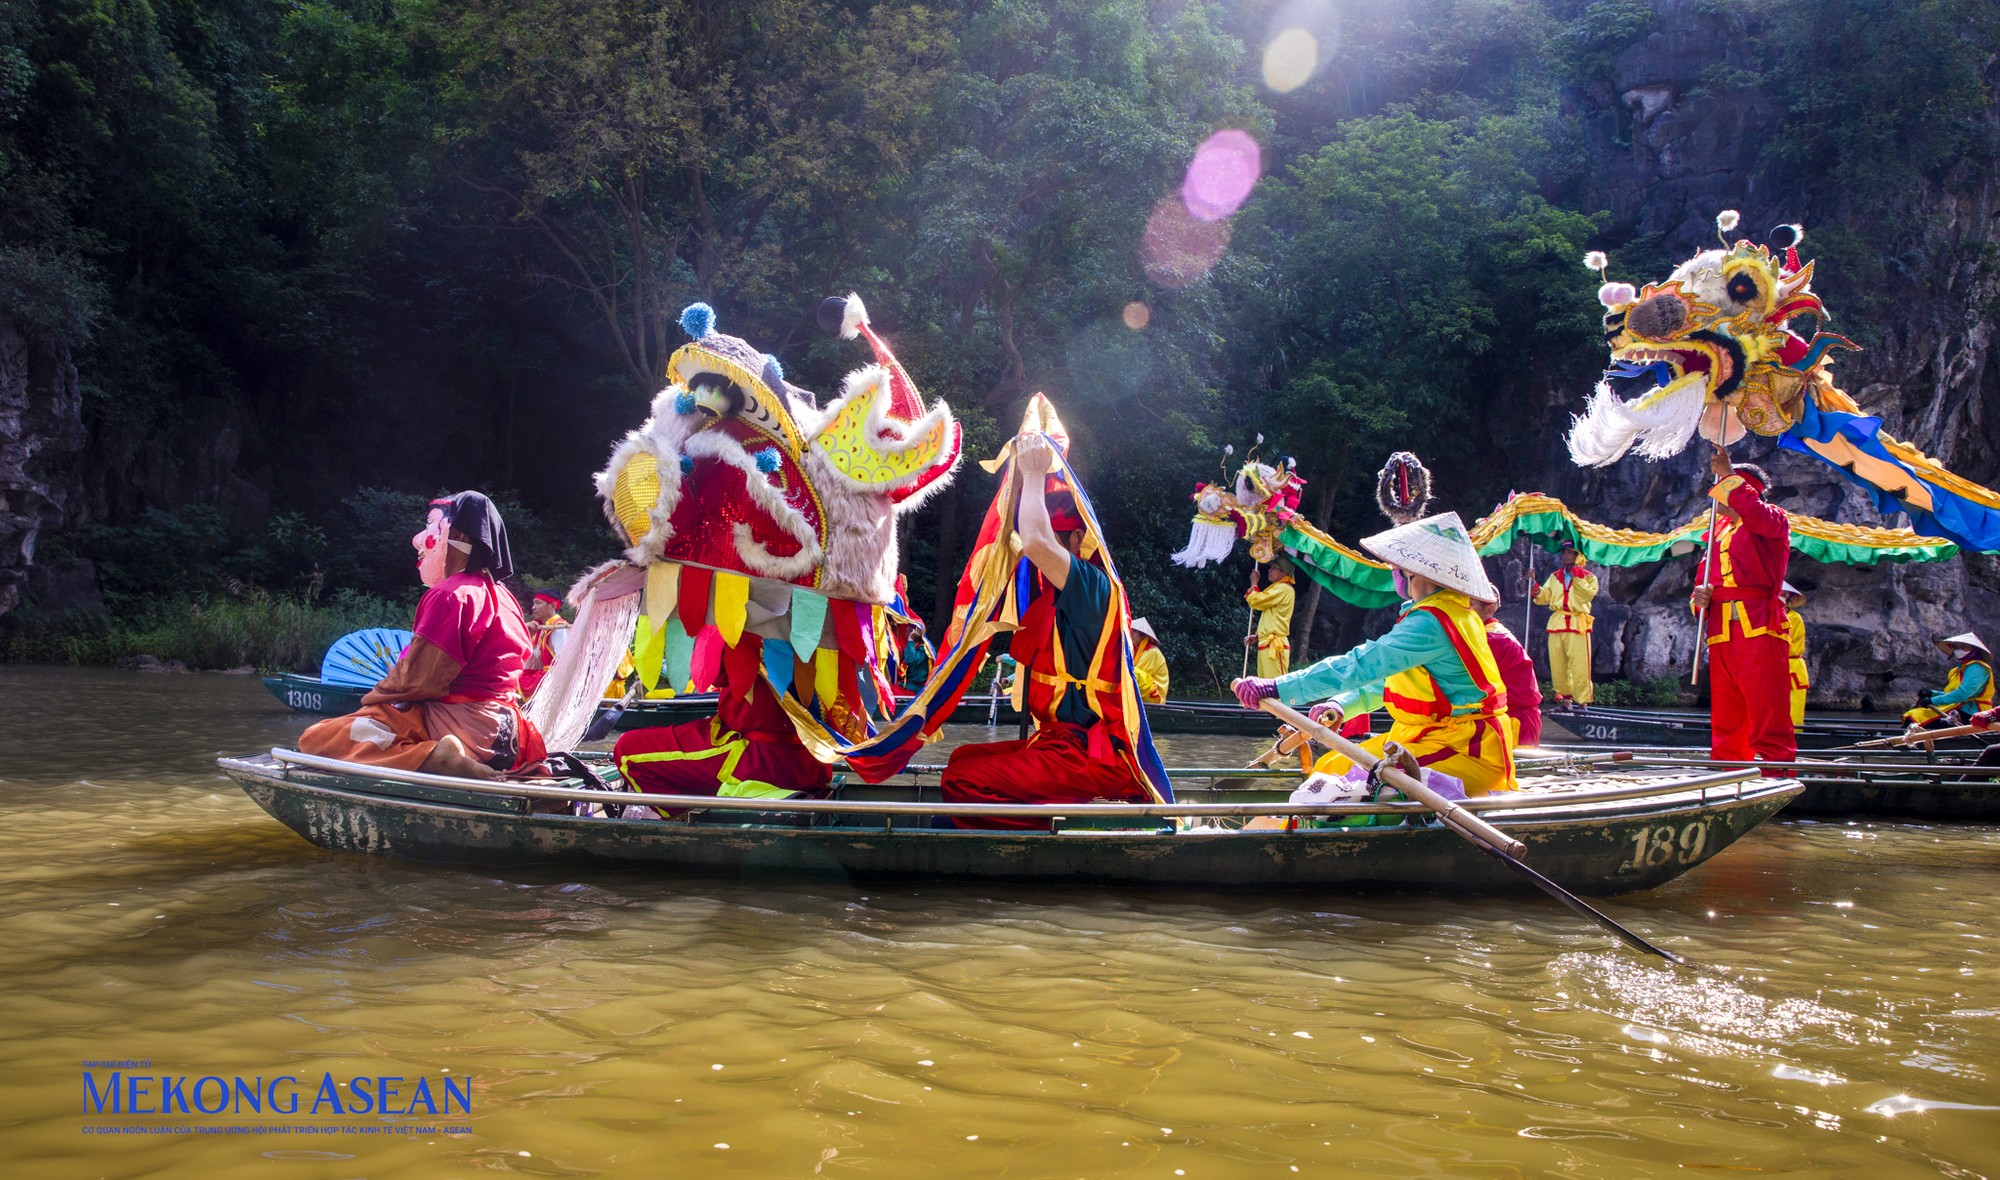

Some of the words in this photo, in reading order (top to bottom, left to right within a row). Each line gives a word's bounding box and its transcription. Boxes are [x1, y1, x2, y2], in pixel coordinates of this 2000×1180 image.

[1447, 564, 1471, 582] An
[287, 689, 322, 711] 1308
[1585, 724, 1618, 741] 204
[1631, 821, 1707, 869] 189
